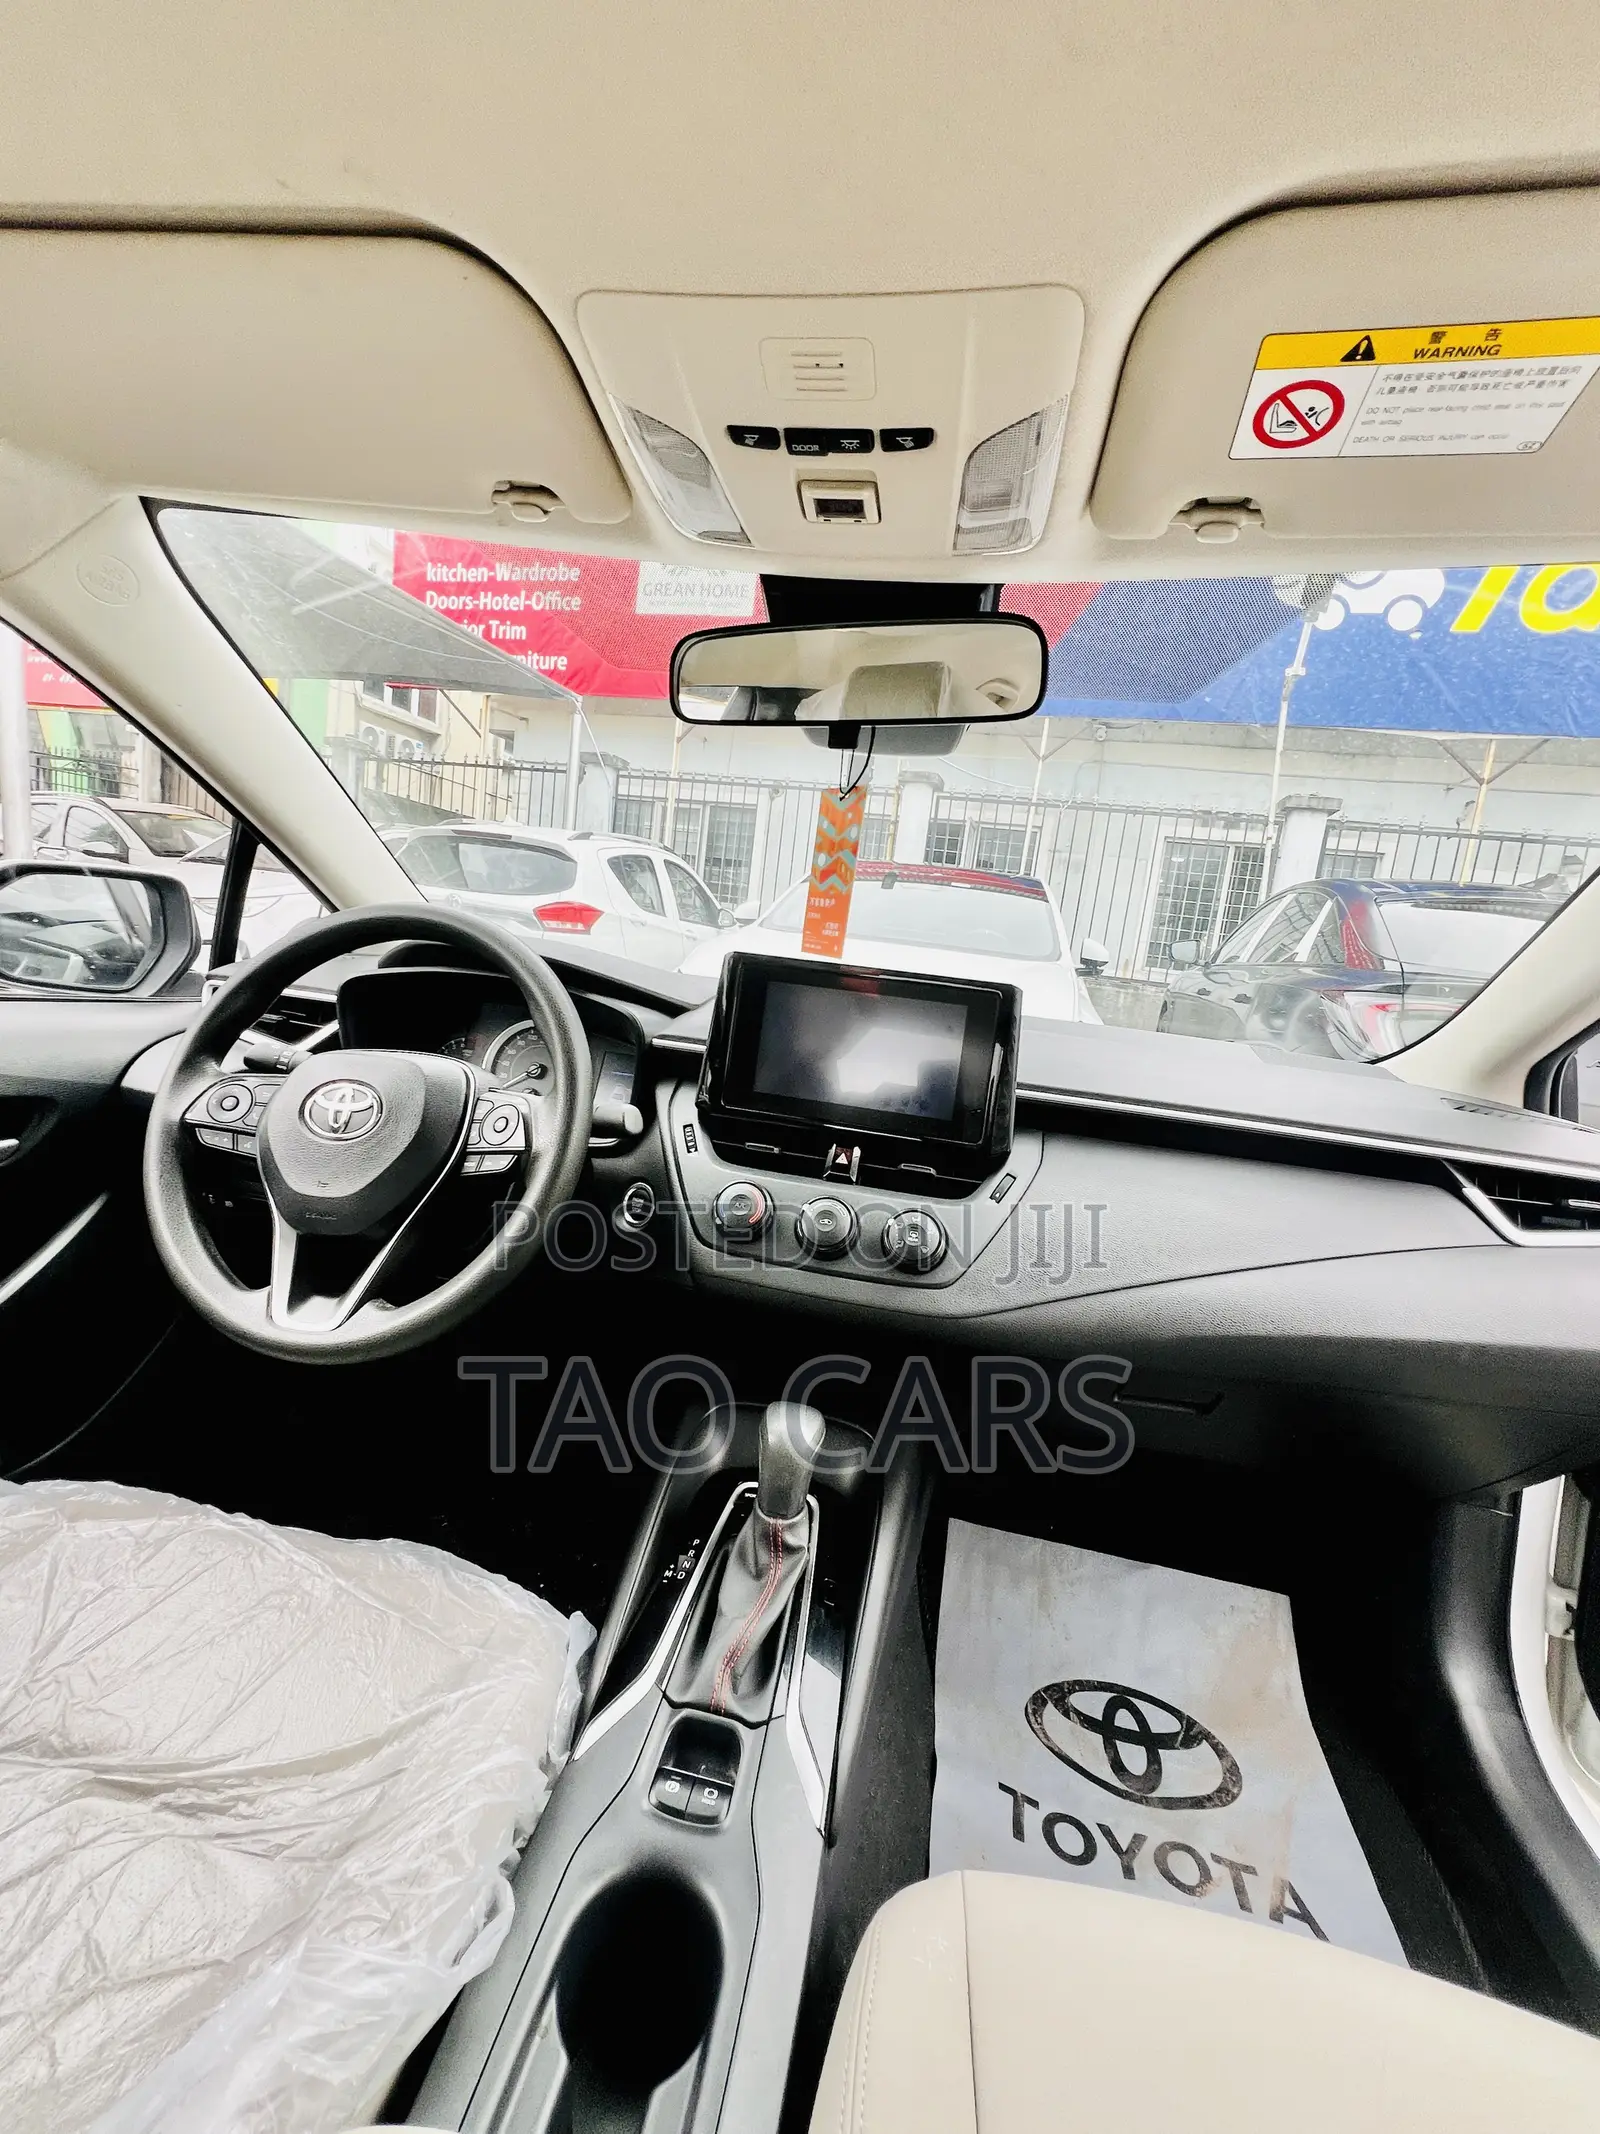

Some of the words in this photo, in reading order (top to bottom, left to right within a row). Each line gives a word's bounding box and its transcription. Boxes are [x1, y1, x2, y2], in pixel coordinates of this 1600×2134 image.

[1413, 344, 1502, 360] WARNING
[791, 444, 820, 452] DOOR
[426, 562, 581, 582] kitchen-Wardrobe
[642, 581, 697, 598] GREAN
[700, 583, 750, 599] HOME
[425, 590, 582, 611] Doors-Hotel-Office
[489, 619, 527, 640] Trim
[692, 1538, 700, 1546] P
[687, 1549, 695, 1557] R
[682, 1560, 691, 1569] N
[998, 1781, 1331, 1943] TOYOTA
